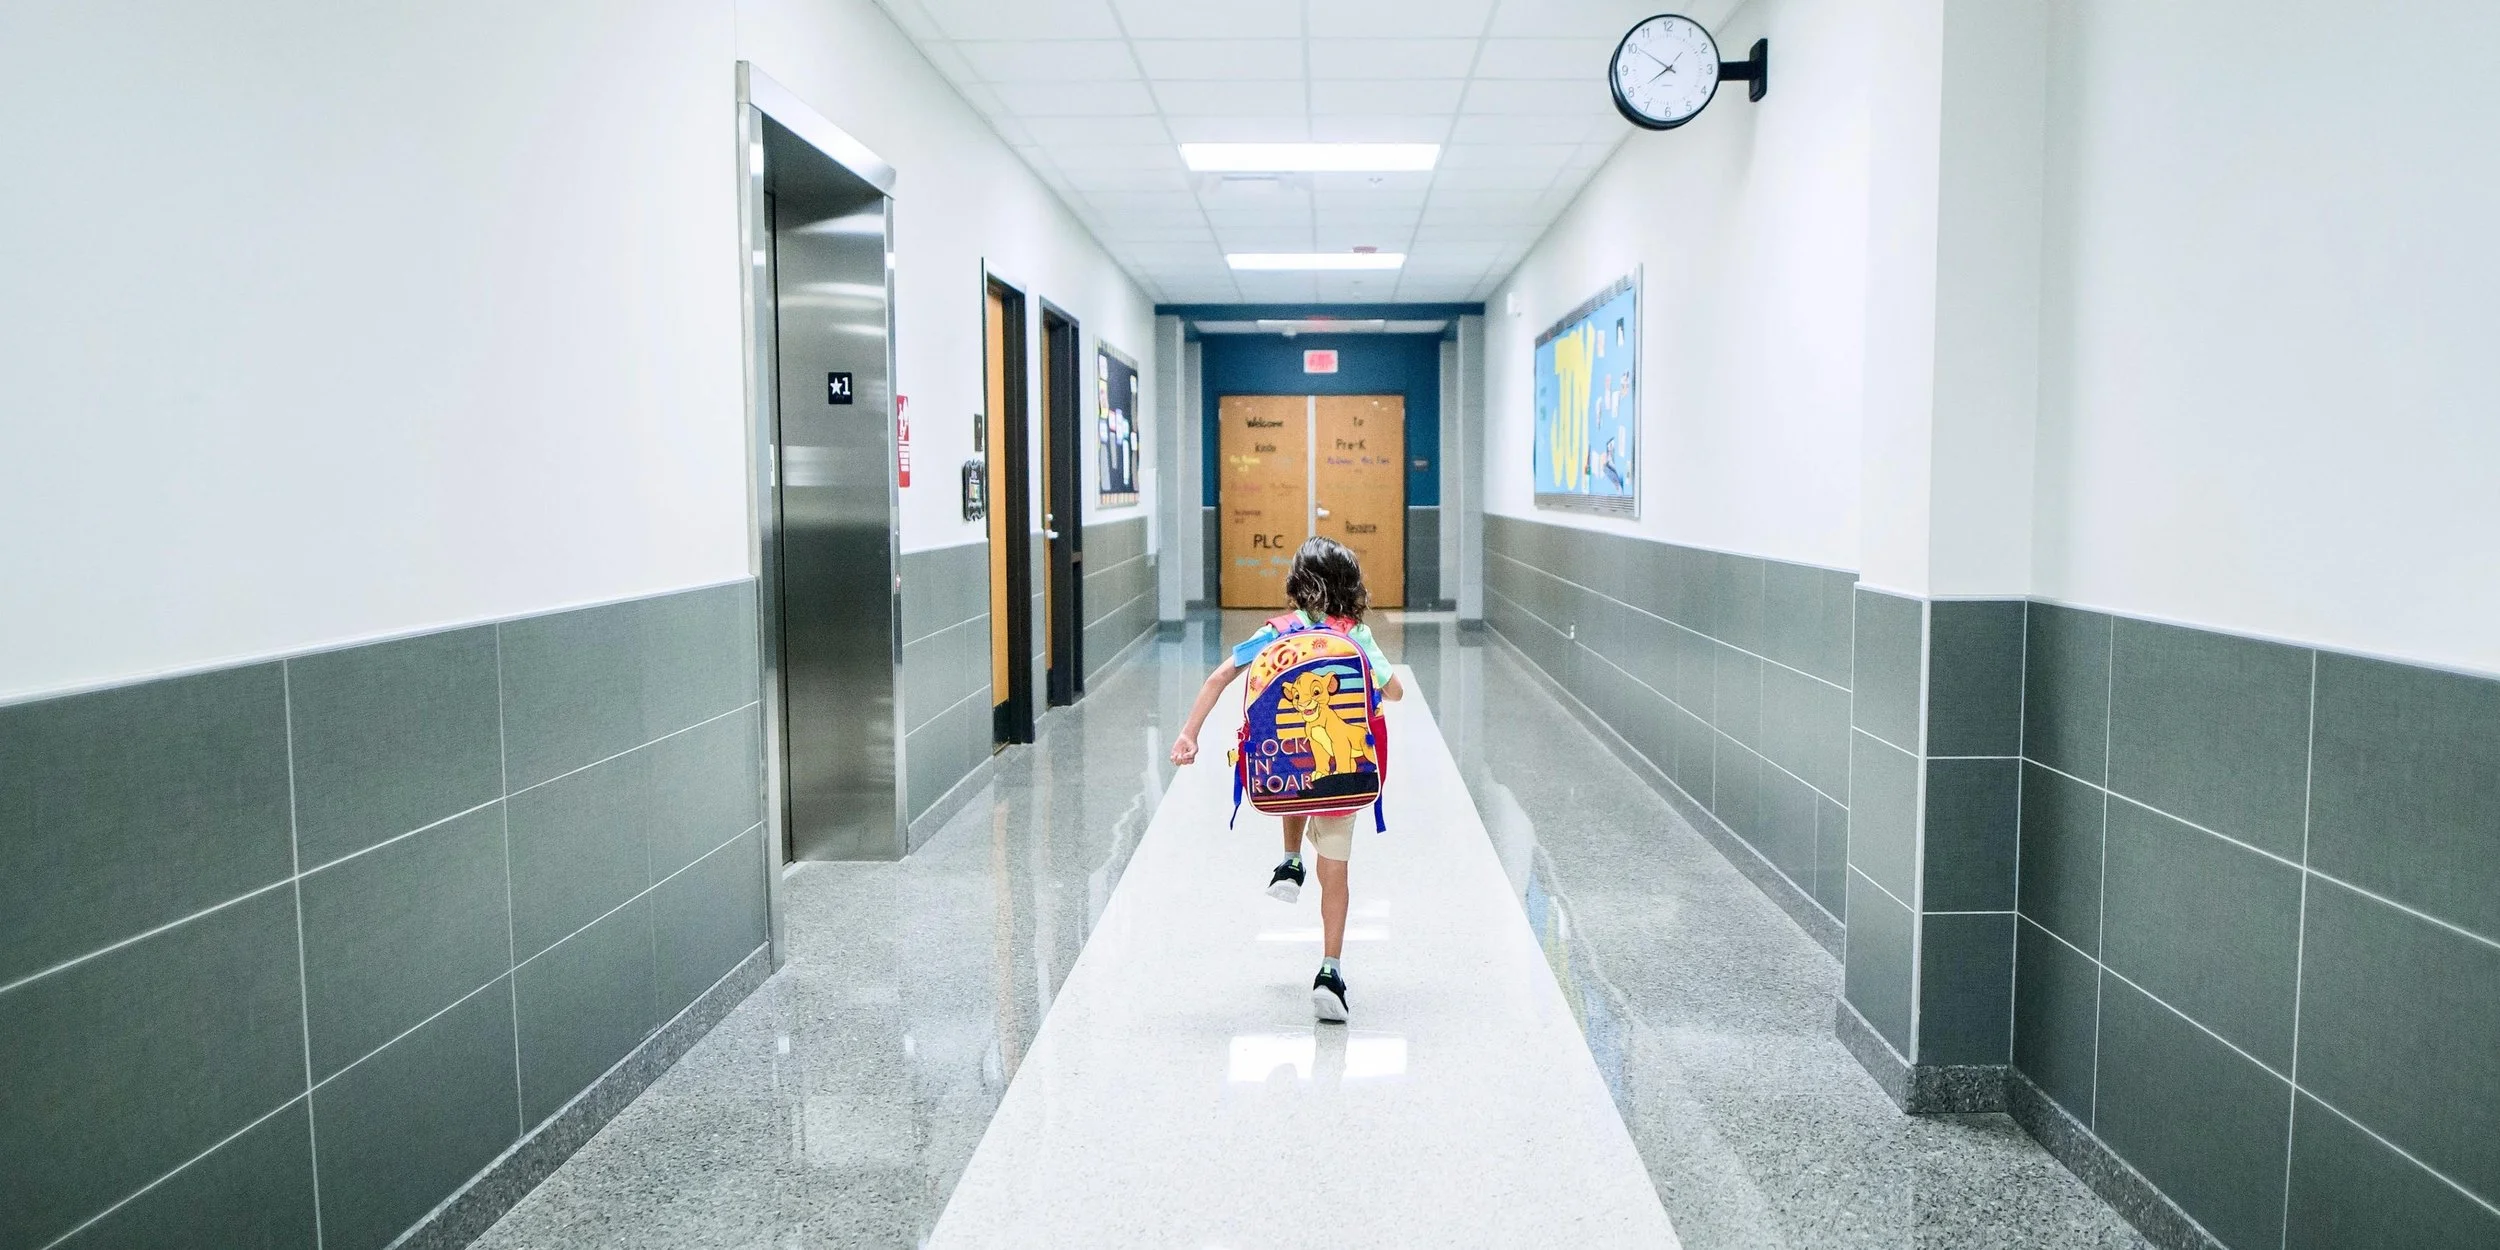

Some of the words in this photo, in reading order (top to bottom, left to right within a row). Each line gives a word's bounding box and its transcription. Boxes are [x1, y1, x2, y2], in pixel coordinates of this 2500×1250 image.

[1663, 21, 1673, 32] 12
[1641, 28, 1650, 38] 11
[1627, 43, 1637, 54] 10
[1701, 43, 1708, 54] 2
[1621, 65, 1629, 76] 9
[1706, 64, 1713, 75] 3
[1628, 87, 1635, 98] 8
[1701, 85, 1707, 95] 4
[1644, 102, 1651, 112] 7
[1686, 101, 1693, 111] 5
[1665, 107, 1672, 117] 6
[1552, 320, 1595, 491] JOY
[1253, 534, 1284, 549] PLC
[1252, 774, 1313, 793] ROAR
